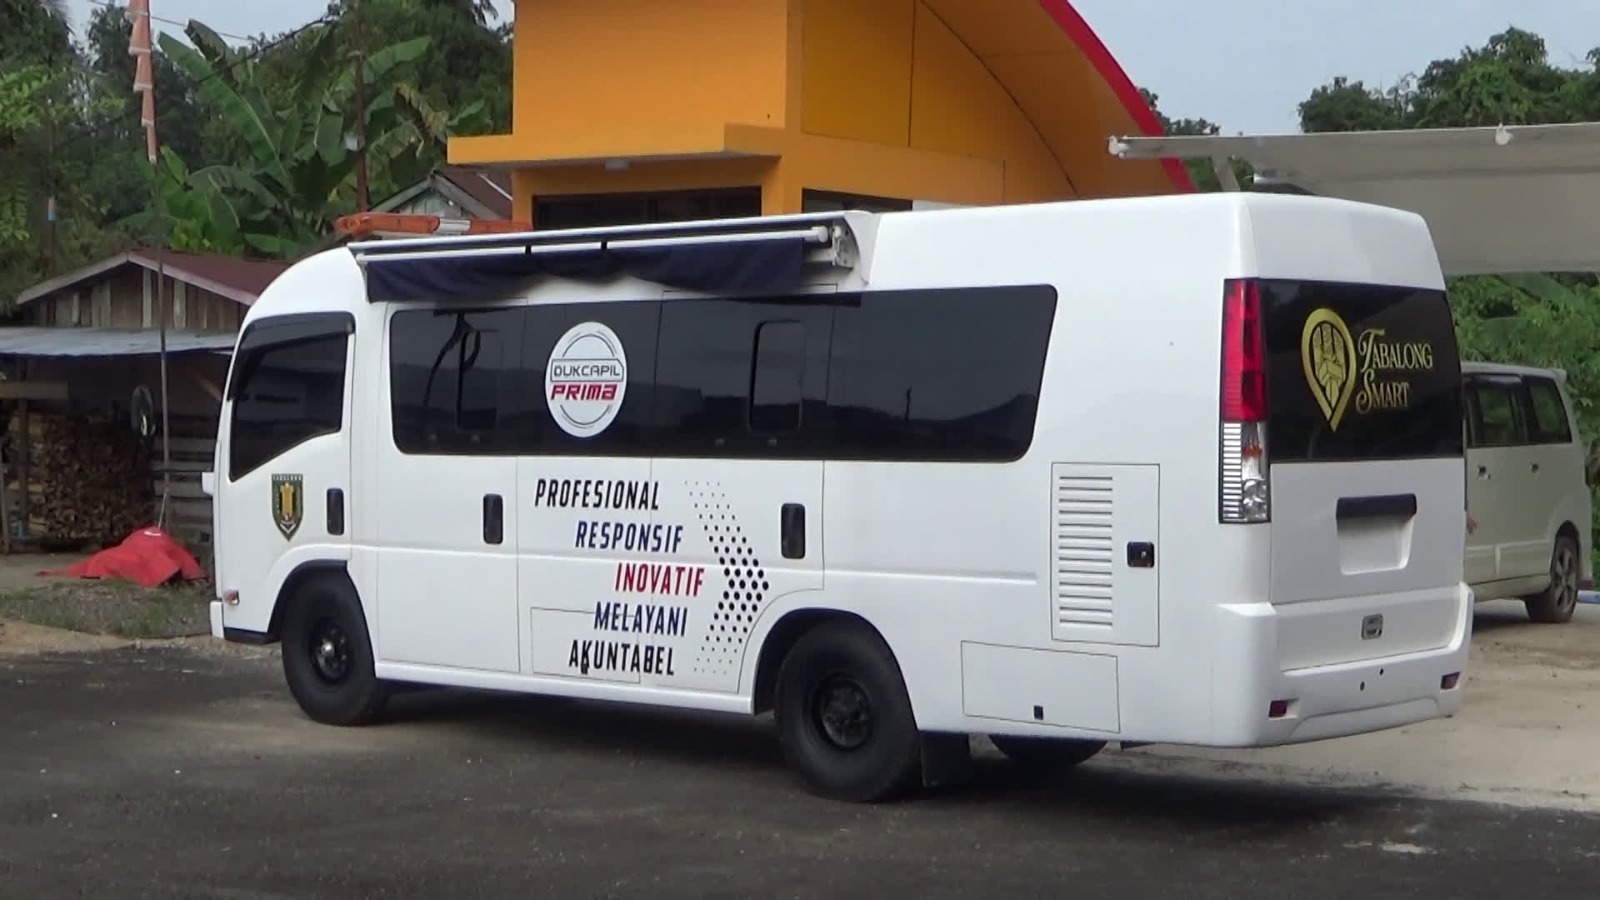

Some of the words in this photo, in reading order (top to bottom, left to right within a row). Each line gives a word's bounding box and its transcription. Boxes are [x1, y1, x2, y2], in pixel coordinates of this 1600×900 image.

[554, 364, 620, 377] DUKCAPIL
[1356, 369, 1409, 413] SMART
[535, 479, 659, 510] PROFESIONAL
[575, 521, 683, 553] RESPONSIF
[615, 563, 704, 596] INOVATIF
[594, 602, 687, 636] MELAYANI
[569, 639, 675, 675] AKUNTABEL
